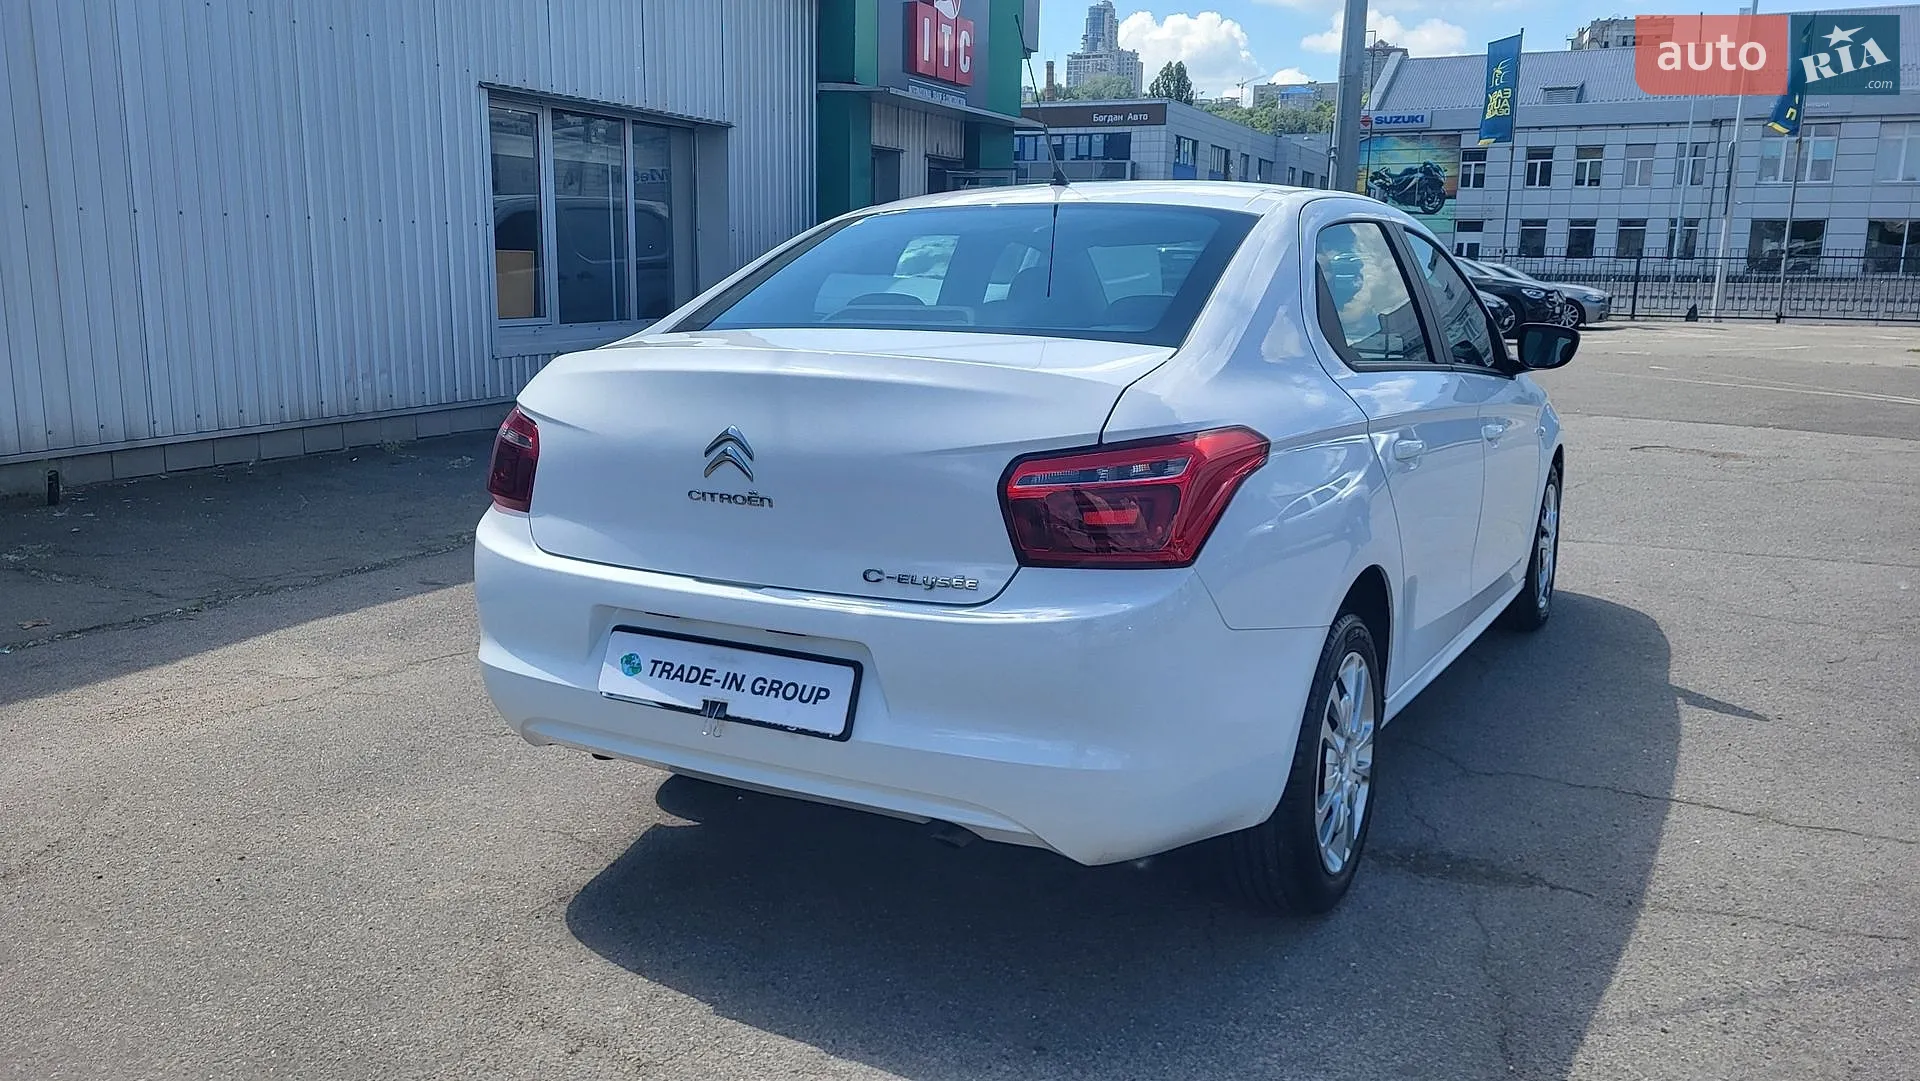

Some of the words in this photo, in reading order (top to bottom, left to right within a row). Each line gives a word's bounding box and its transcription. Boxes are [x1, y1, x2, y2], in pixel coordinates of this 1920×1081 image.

[923, 17, 971, 73] ITC
[1093, 113, 1124, 123] Богдан
[1127, 113, 1149, 121] Авто
[1374, 114, 1425, 124] SUZUKI
